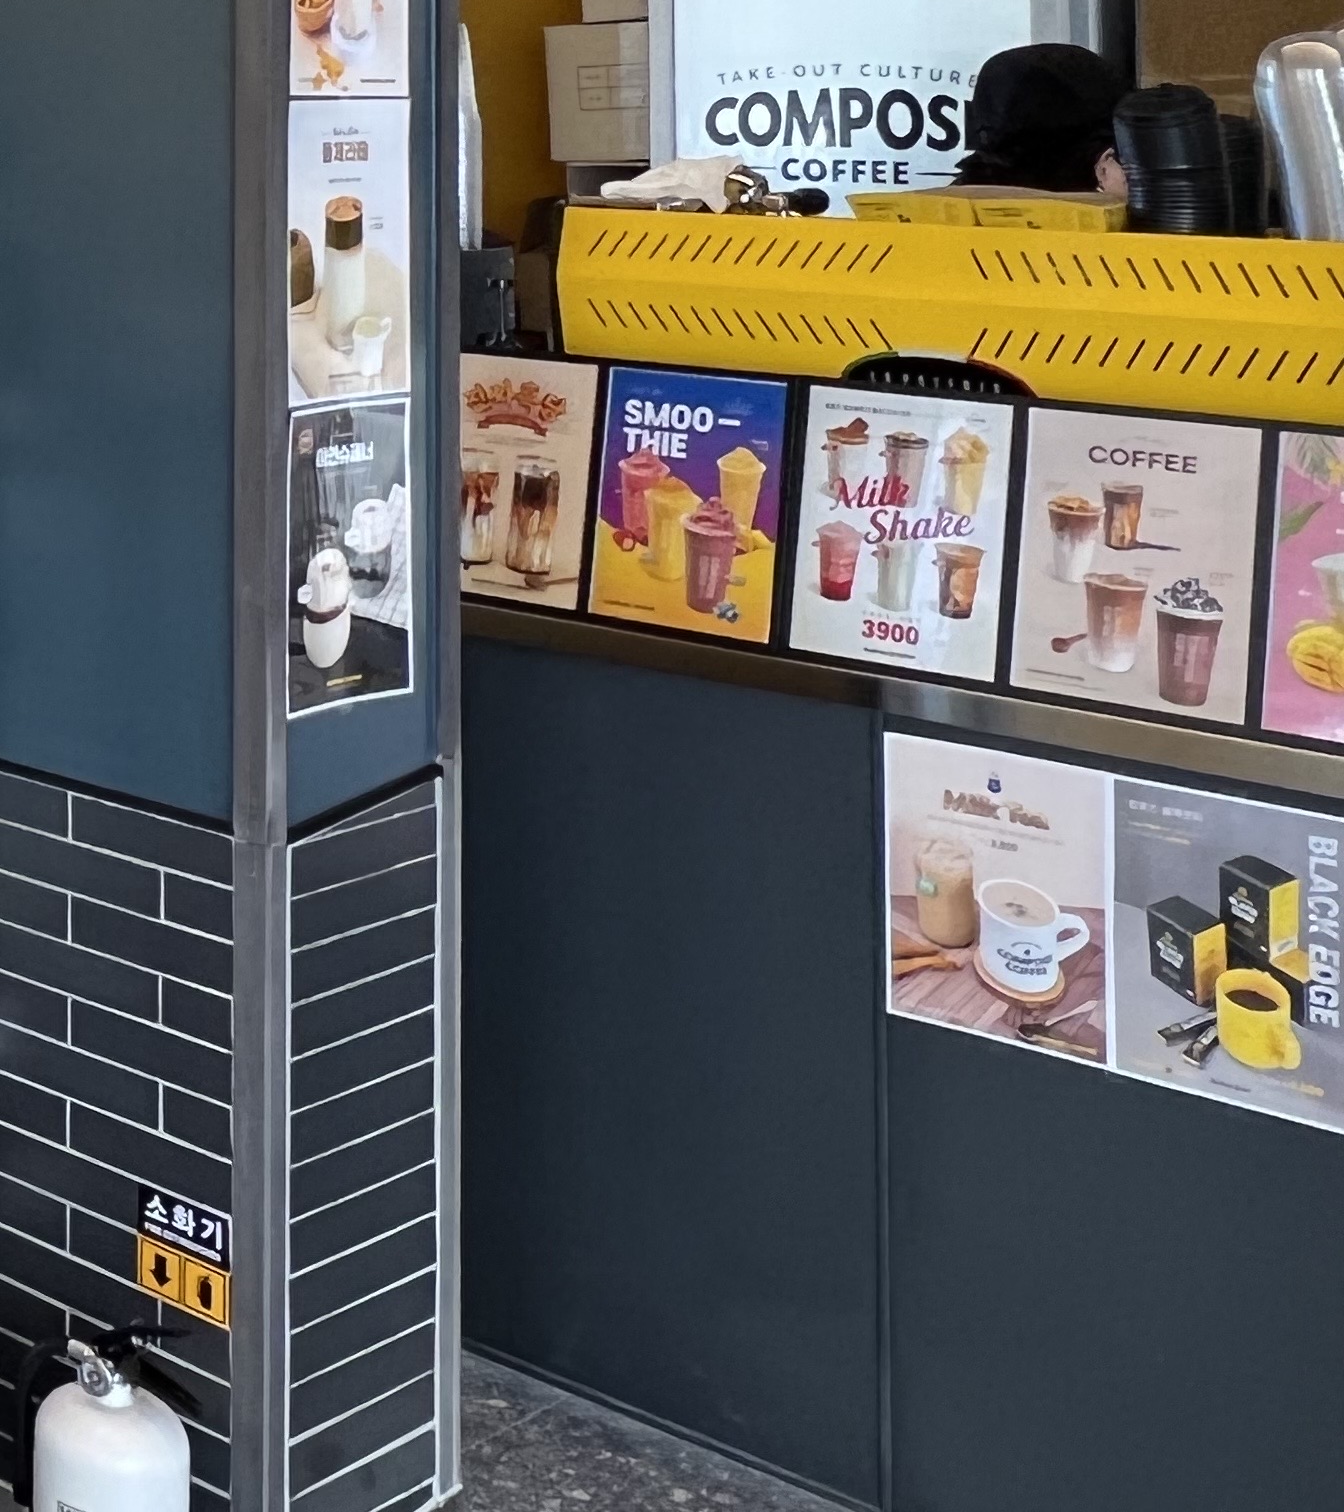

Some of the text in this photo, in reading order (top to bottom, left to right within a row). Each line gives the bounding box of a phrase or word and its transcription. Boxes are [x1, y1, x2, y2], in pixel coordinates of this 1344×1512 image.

[717, 62, 977, 88] TAKE-OUT CULTURE
[781, 158, 909, 185] COFFEE
[622, 426, 689, 460] THIE
[1088, 445, 1198, 474] COFFEE
[828, 472, 912, 512] Milk
[863, 507, 976, 546] Shake
[861, 618, 920, 646] 3900
[1308, 835, 1341, 1029] BLACK EDGE
[144, 1194, 223, 1251] 소화기
